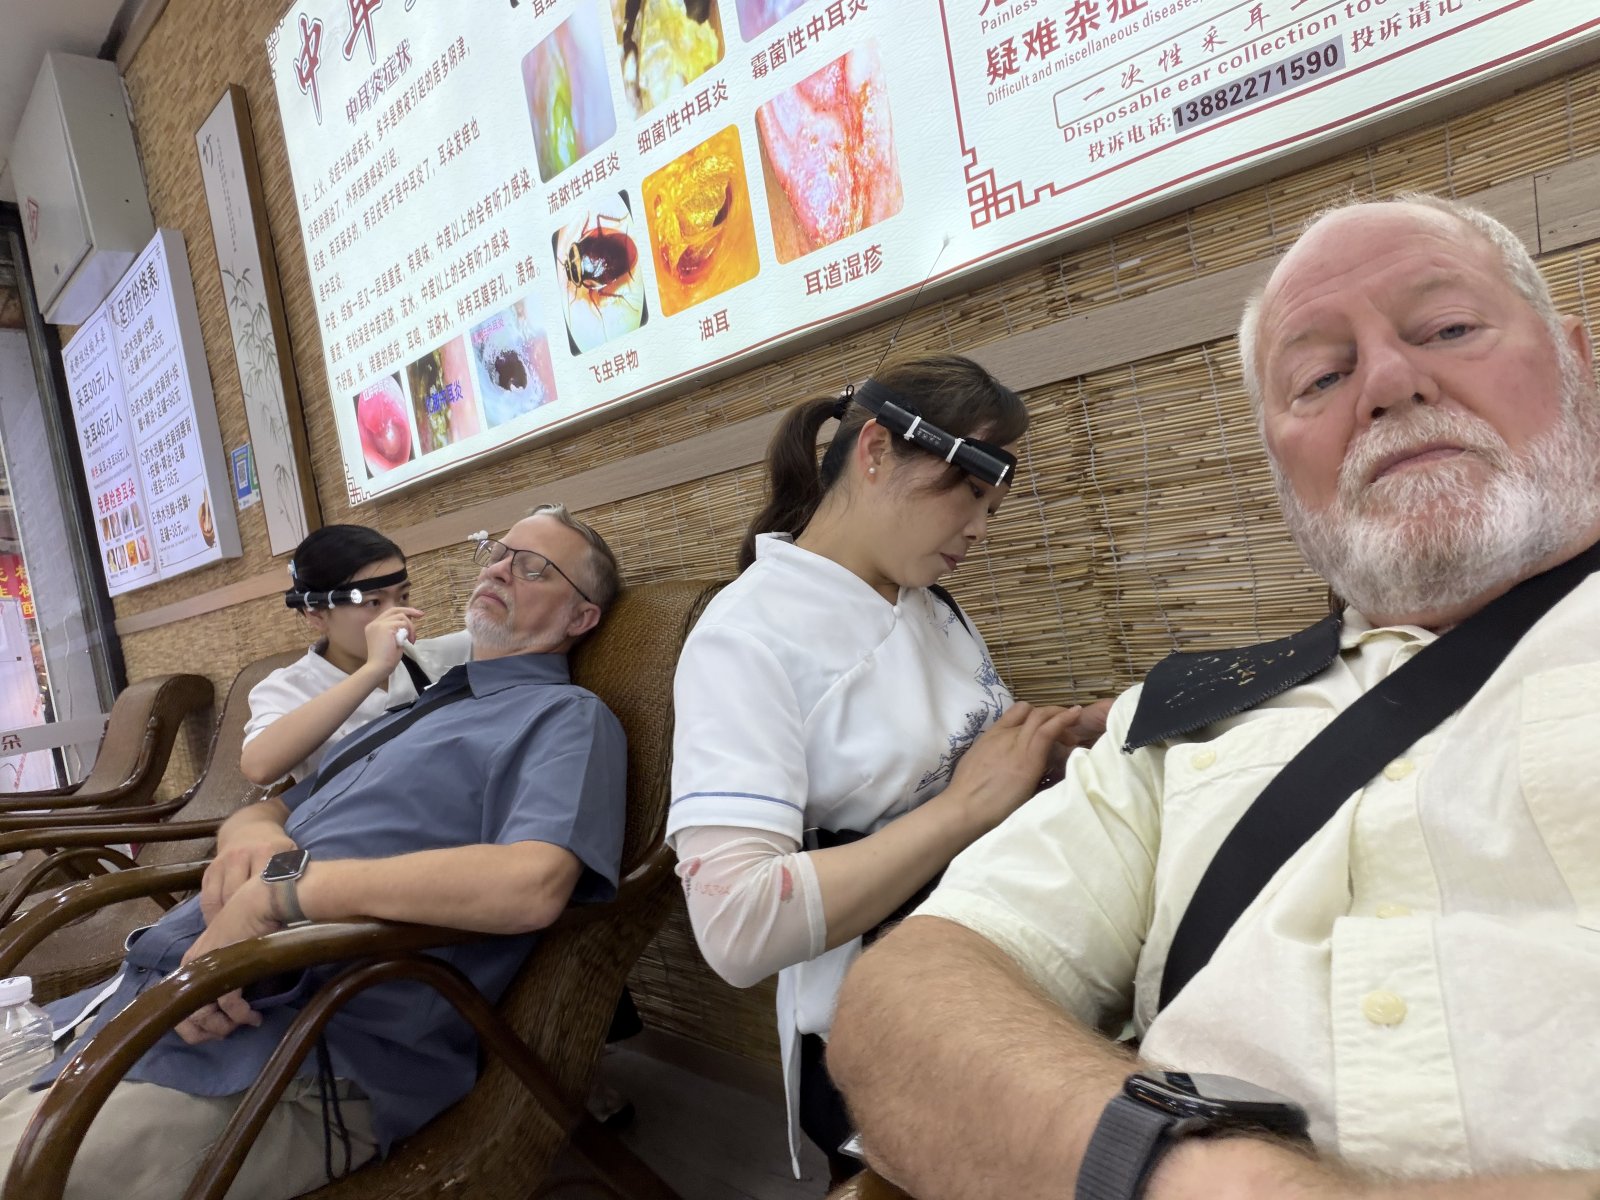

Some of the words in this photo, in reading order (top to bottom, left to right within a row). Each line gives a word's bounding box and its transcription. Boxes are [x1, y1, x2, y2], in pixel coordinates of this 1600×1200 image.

[981, 0, 1038, 34] Painless
[345, 38, 413, 126] 中耳炎症状
[987, 75, 1030, 106] Difficult
[1032, 61, 1053, 84] and
[1055, 22, 1140, 75] miscellaneous
[1063, 86, 1172, 143] Disposable
[1178, 67, 1211, 92] ear
[1217, 14, 1337, 75] collection
[1083, 0, 1307, 101] 一次性采耳
[637, 77, 729, 156] 细菌性中耳炎
[1088, 112, 1172, 163] 投诉电话:
[1173, 43, 1338, 127] 13882271590
[547, 151, 621, 215] 流脓性中耳炎
[118, 260, 159, 330] 足疗价格表
[804, 243, 883, 296] 耳道湿疹
[698, 309, 731, 341] 油耳
[75, 361, 114, 412] 采耳30元/人
[588, 348, 640, 384] 飞虫异物
[84, 403, 123, 449] 洗耳48元/人
[97, 477, 137, 516] 免费检查耳朵
